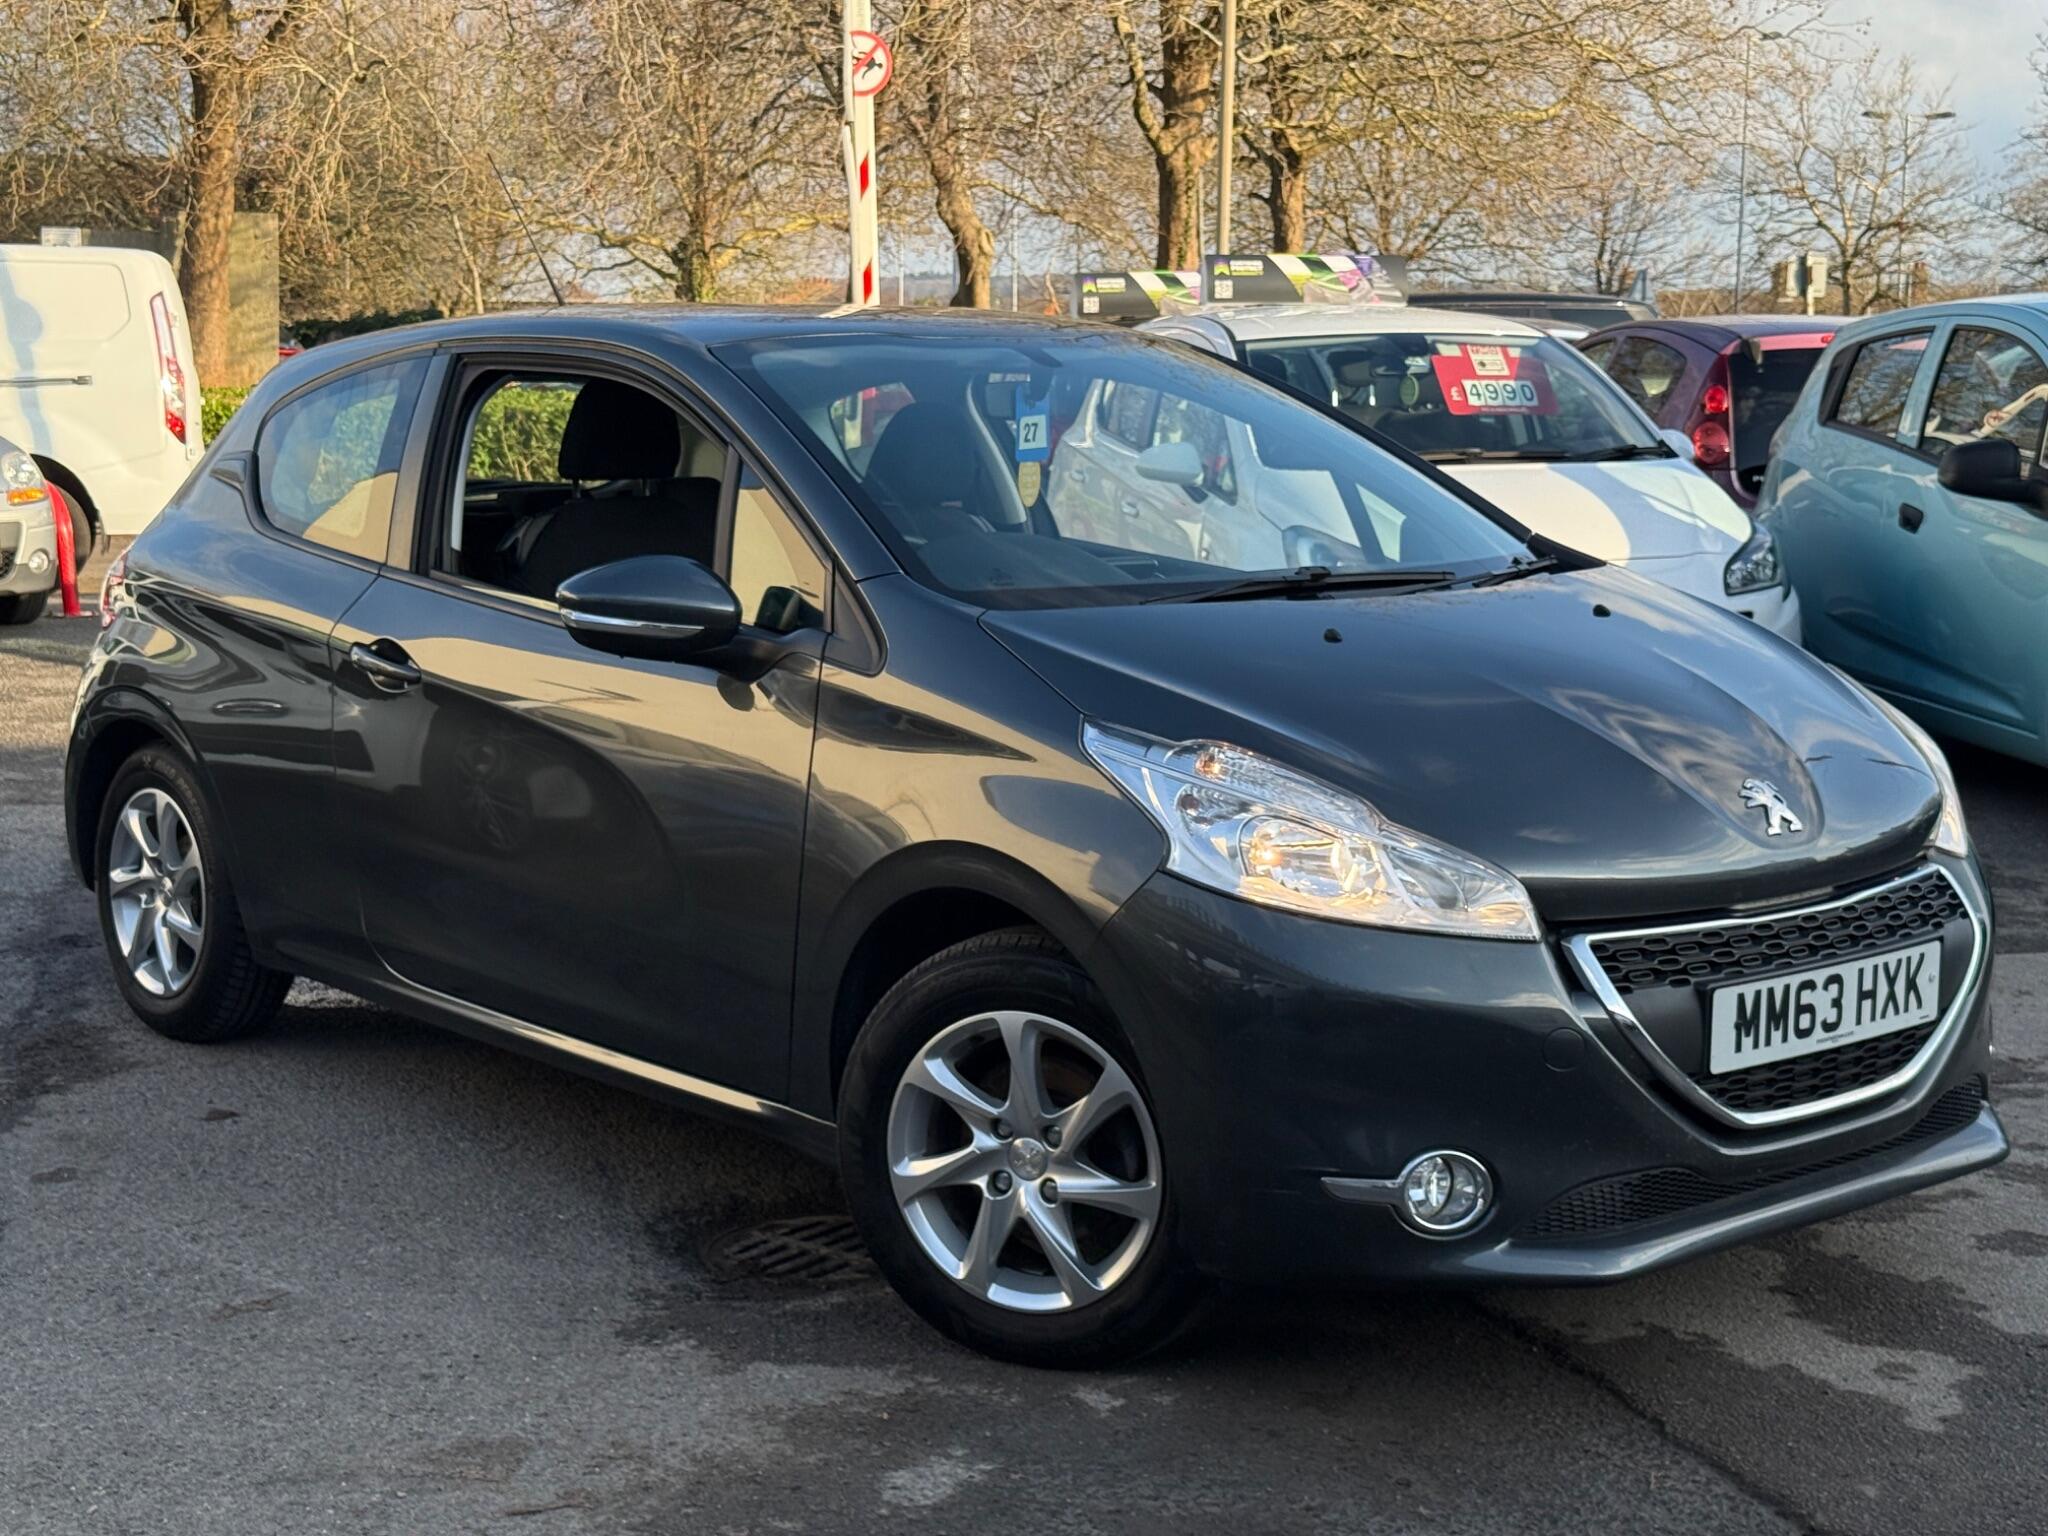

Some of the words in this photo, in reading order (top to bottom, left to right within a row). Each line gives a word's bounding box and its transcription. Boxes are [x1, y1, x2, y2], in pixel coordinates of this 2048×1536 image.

[1469, 383, 1535, 402] 4990
[1023, 422, 1039, 443] 27
[1734, 973, 1844, 1054] MM63
[1855, 952, 1925, 1027] HXK
